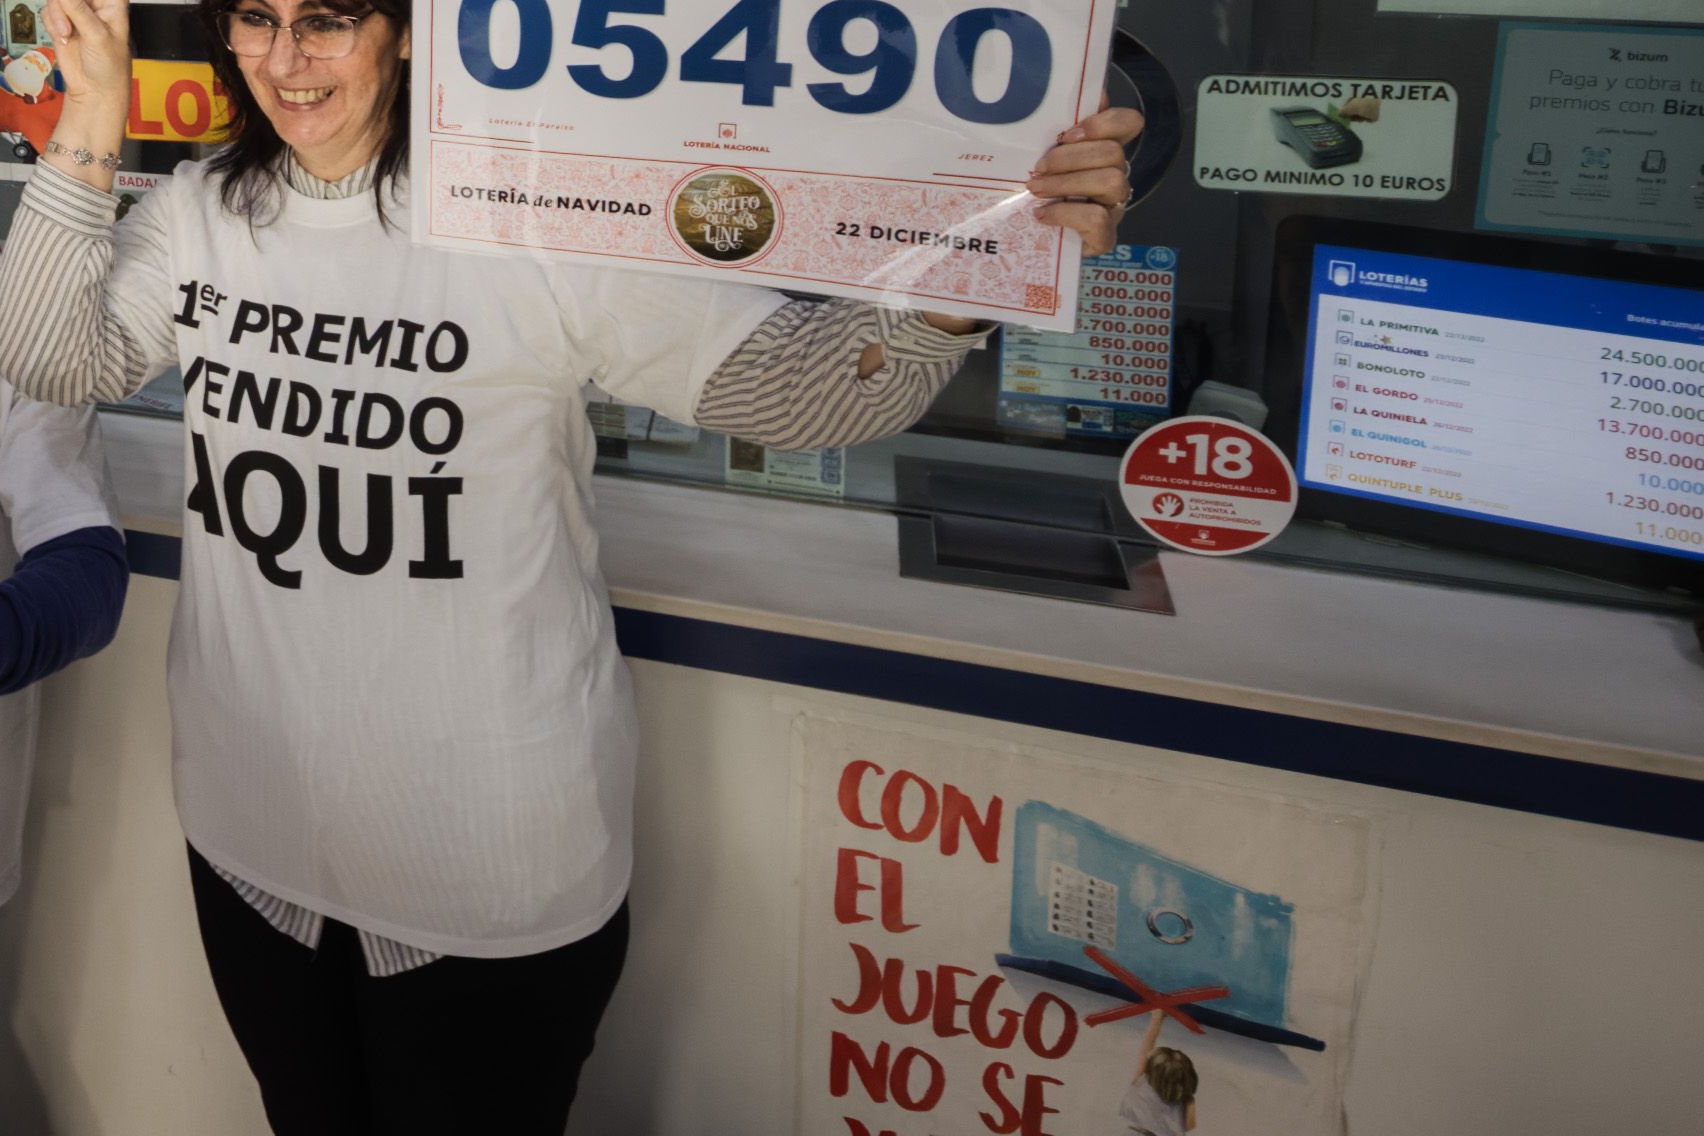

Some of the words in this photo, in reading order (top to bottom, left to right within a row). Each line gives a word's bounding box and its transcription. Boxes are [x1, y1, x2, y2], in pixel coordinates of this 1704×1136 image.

[1627, 51, 1669, 62] bizum
[1206, 79, 1343, 98] ADMITIMOS
[1352, 83, 1450, 102] TARJETA
[957, 153, 995, 162] JEREZ
[1200, 167, 1258, 182] PAGO
[1264, 170, 1344, 186] MINIMO
[1353, 174, 1374, 188] 10
[1380, 176, 1446, 192] EUROS
[451, 184, 528, 205] LOTERÍA
[533, 194, 553, 208] de
[557, 195, 652, 217] NAVIDAD
[835, 222, 861, 237] 22
[870, 226, 998, 255] DICIEMBRE
[228, 298, 469, 373] PREMIO
[1360, 318, 1375, 327] LA
[1379, 320, 1439, 336] PRIMITIVA
[1089, 336, 1169, 354] 850.000
[1354, 340, 1429, 358] EUROMILLONES
[1102, 353, 1168, 370] 10.000
[1356, 362, 1426, 379] BONOLOTO
[1070, 368, 1168, 388] 1.230.000
[1099, 388, 1167, 405] 11.000
[1355, 384, 1369, 393] EL
[1373, 387, 1419, 401] GORDO
[1353, 407, 1368, 415] LA
[1371, 409, 1427, 426] QUINIELA
[1351, 428, 1365, 438] EL
[1367, 430, 1427, 448] QUINIGOL
[1159, 434, 1253, 479] +18
[1350, 450, 1416, 469] LOTOTURF
[1139, 474, 1167, 483] JUEGA
[1170, 477, 1189, 486] CON
[1192, 479, 1277, 495] RESPONSABILIDAD
[1348, 472, 1423, 494] QUINTUPLE
[1429, 487, 1463, 501] PLUS
[1190, 498, 1234, 508] PROHIBIDA
[1189, 513, 1262, 526] AUTOPROHIBIDOS
[837, 760, 1003, 863] CON
[834, 847, 921, 933] EL
[831, 942, 1079, 1059] JUEGO
[829, 1031, 945, 1112] NO
[978, 1061, 1065, 1136] SE
